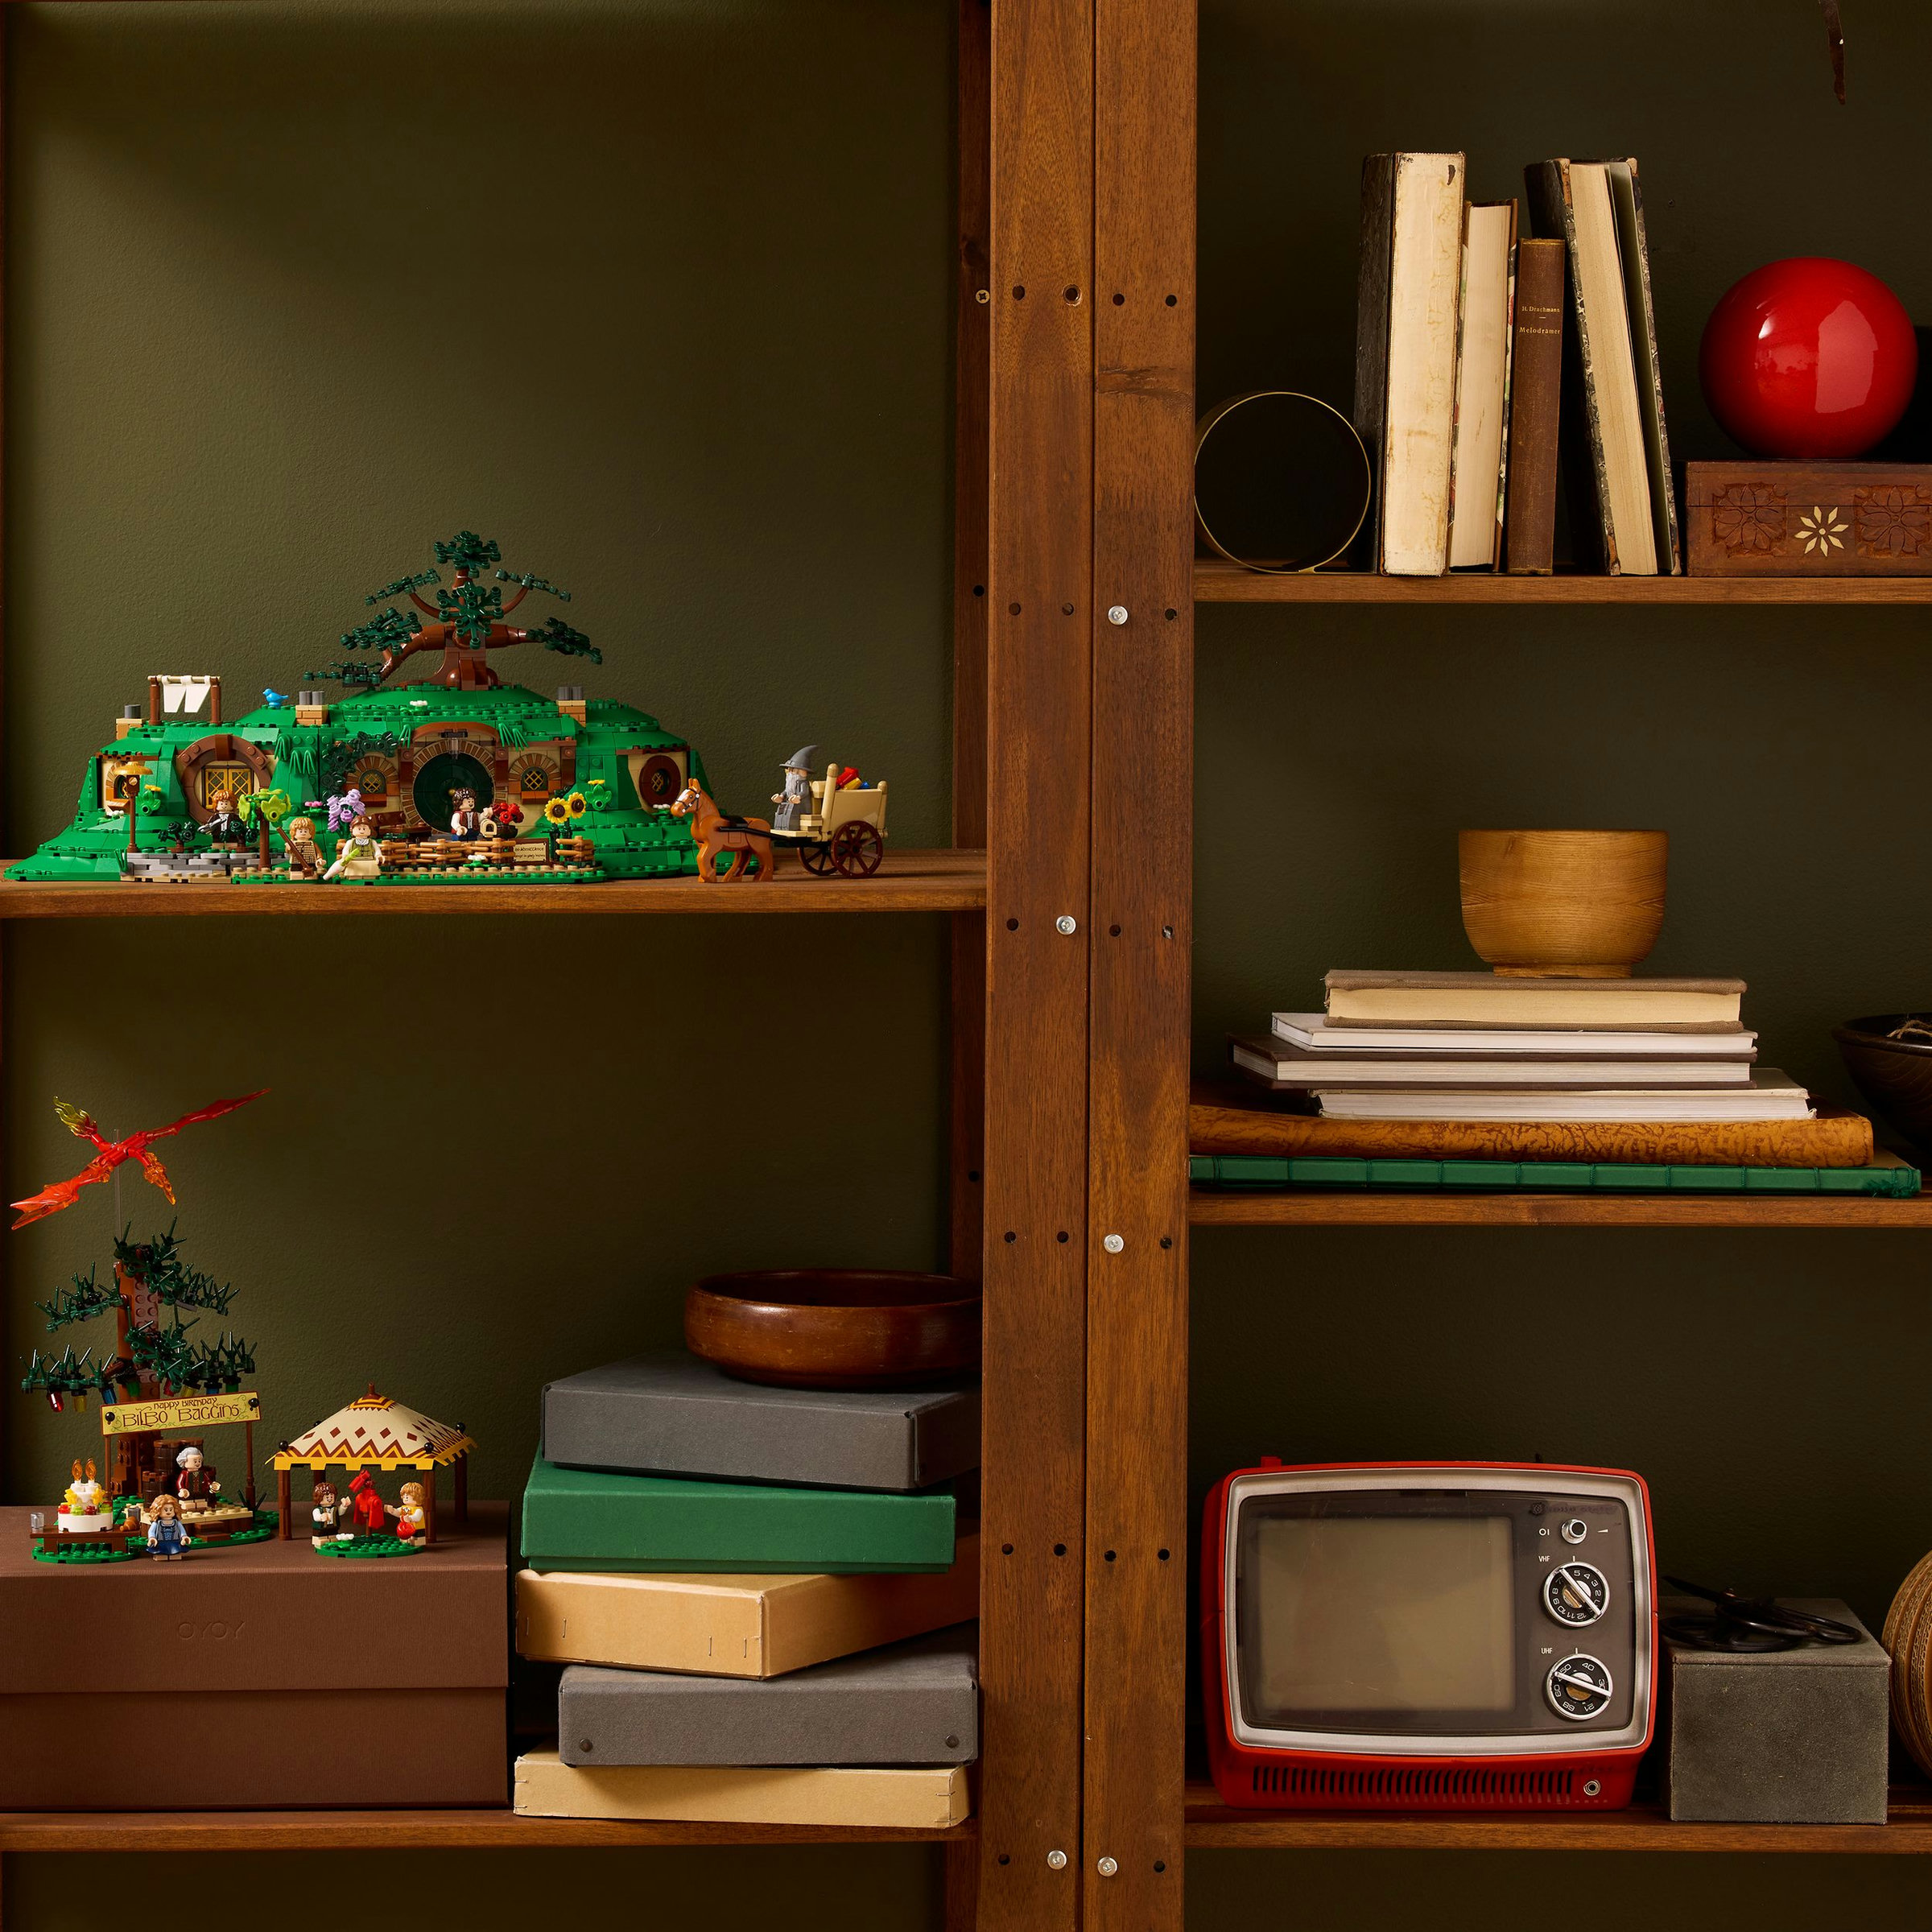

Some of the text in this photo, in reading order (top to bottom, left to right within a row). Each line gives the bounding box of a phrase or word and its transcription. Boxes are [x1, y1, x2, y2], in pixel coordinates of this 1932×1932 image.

[1591, 1579, 1599, 1587] 3
[178, 1620, 246, 1641] OYOY
[1559, 1663, 1572, 1674] 50
[1581, 1662, 1595, 1671] 40
